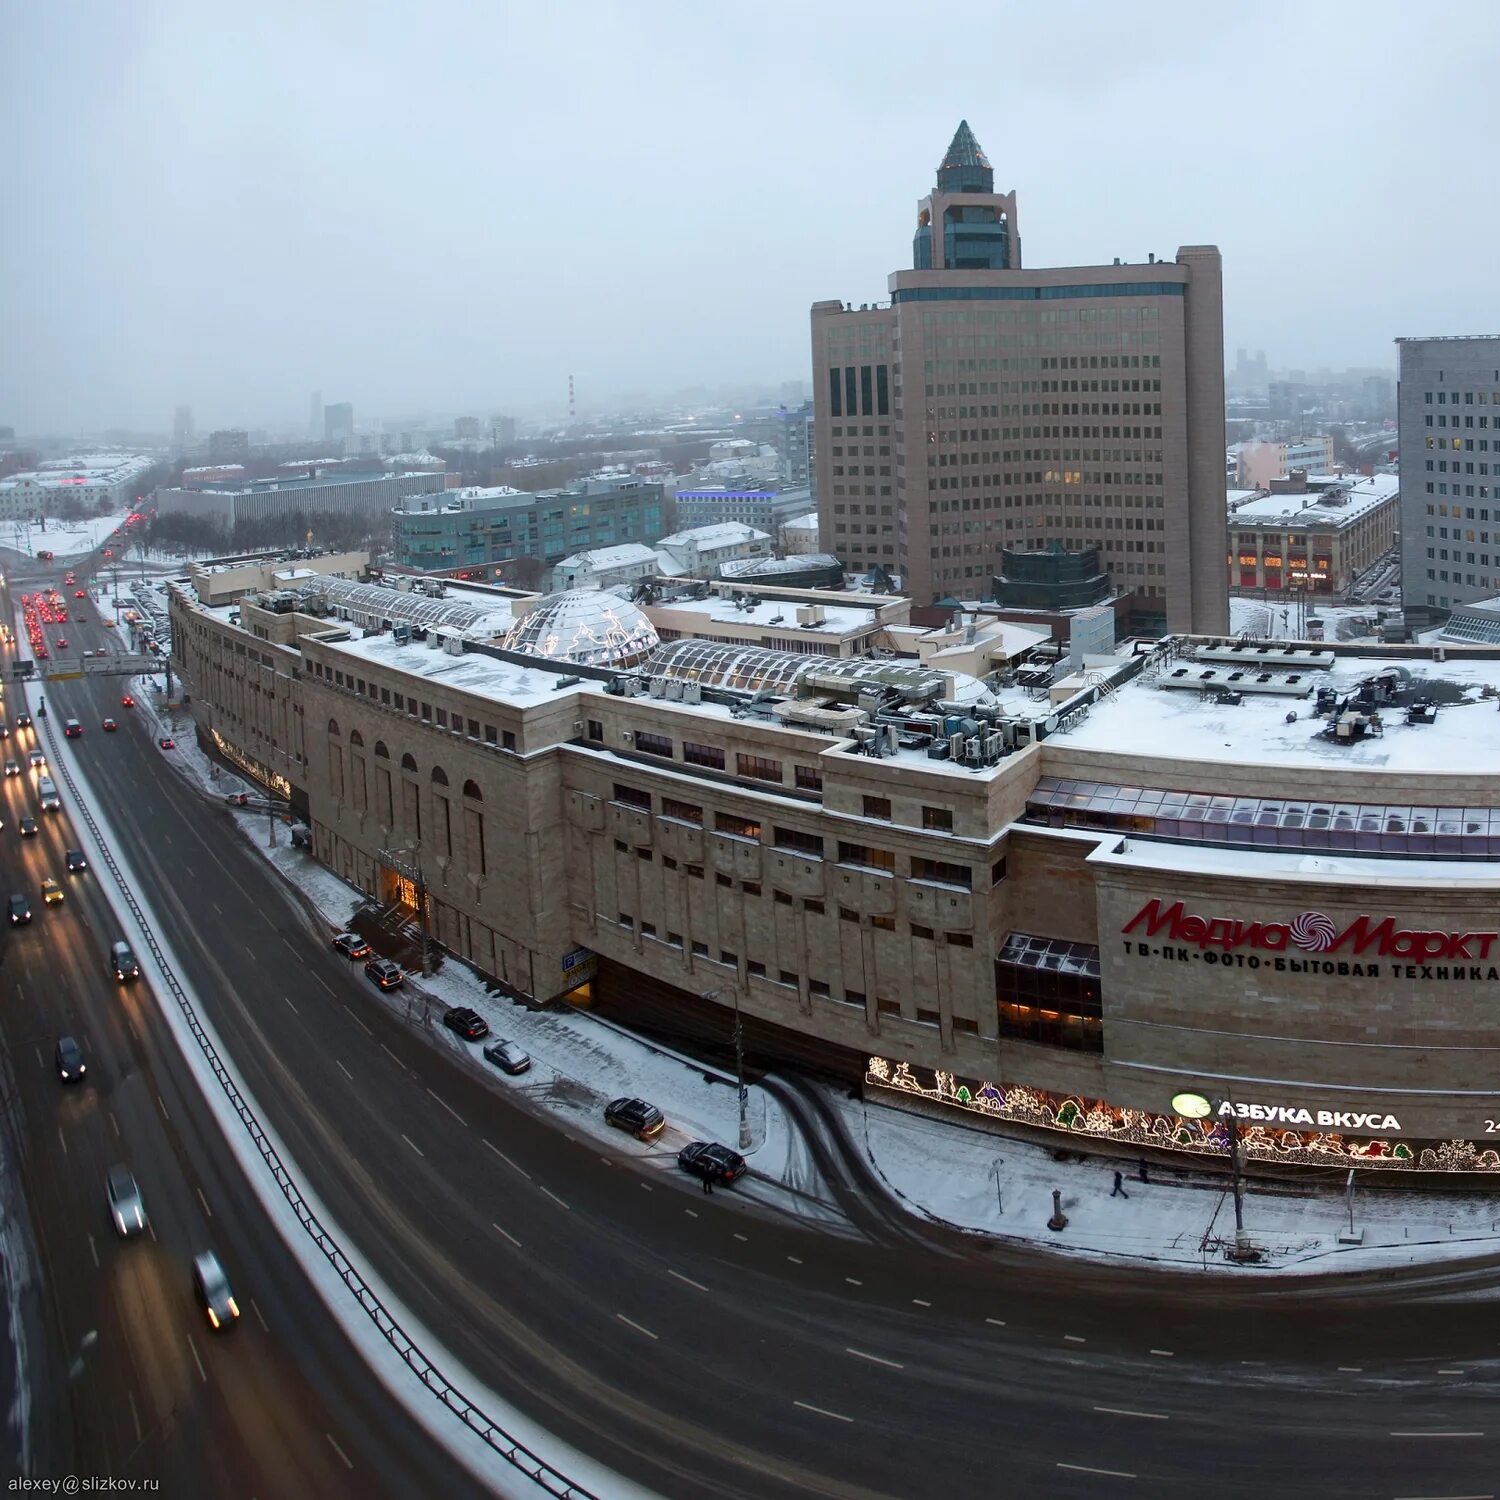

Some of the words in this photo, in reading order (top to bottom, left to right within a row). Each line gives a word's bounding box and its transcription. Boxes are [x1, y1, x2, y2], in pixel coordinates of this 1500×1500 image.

[1121, 898, 1289, 951] Медиа
[1331, 915, 1498, 965] Маркт
[1391, 964, 1500, 981] ТЕХНИКА
[1217, 1099, 1313, 1125] АЗБУКА
[1317, 1109, 1401, 1130] ВКУСА
